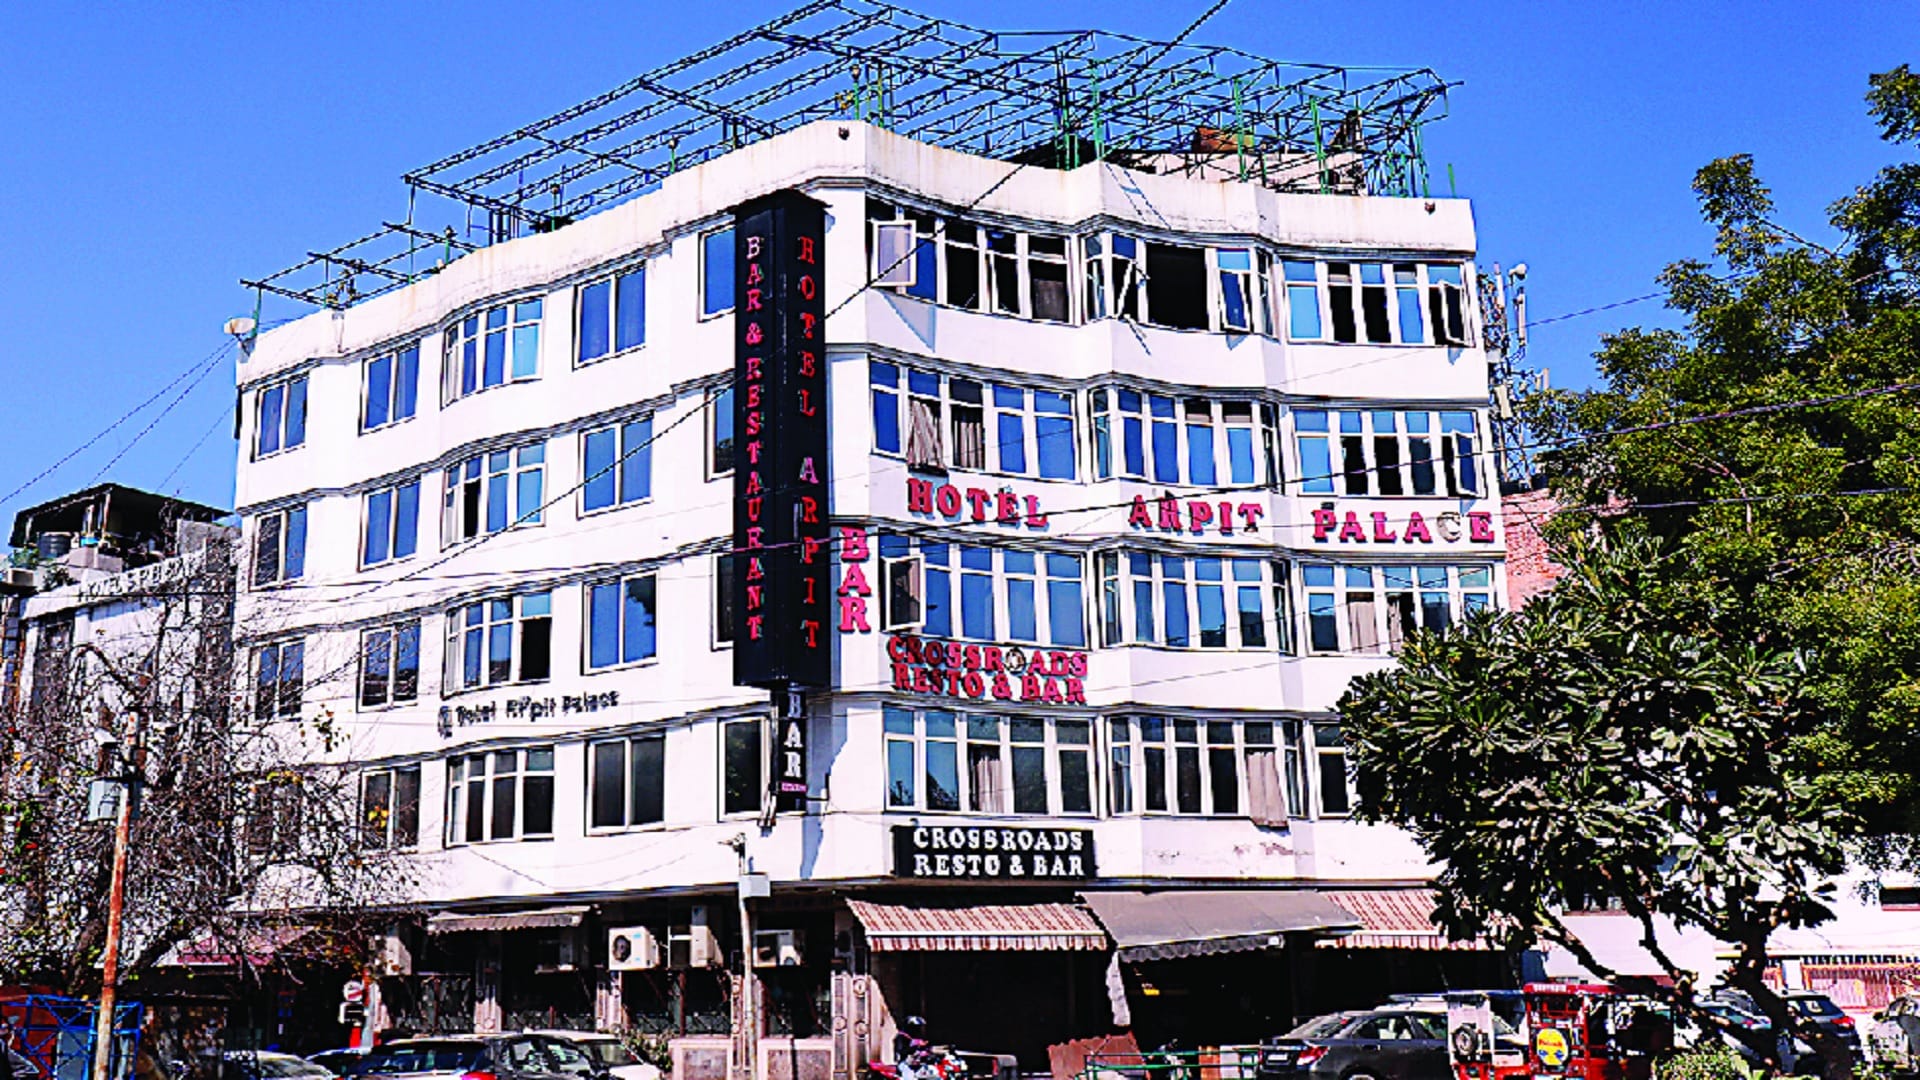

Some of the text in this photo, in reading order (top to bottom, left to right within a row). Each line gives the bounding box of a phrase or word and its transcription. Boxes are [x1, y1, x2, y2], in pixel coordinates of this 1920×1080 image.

[745, 236, 764, 640] BAR & RESTAURANT
[798, 236, 819, 648] HOTEL ARPIT
[906, 478, 1496, 543] HOTEL ARPIT PALACE
[837, 526, 871, 633] BAR
[887, 635, 1088, 677] CROSSROADS
[890, 663, 1087, 704] RESTO & BAR
[784, 692, 803, 778] BAR
[912, 827, 1084, 851] CROSSROADS
[913, 853, 1085, 877] RESTO & BAR
